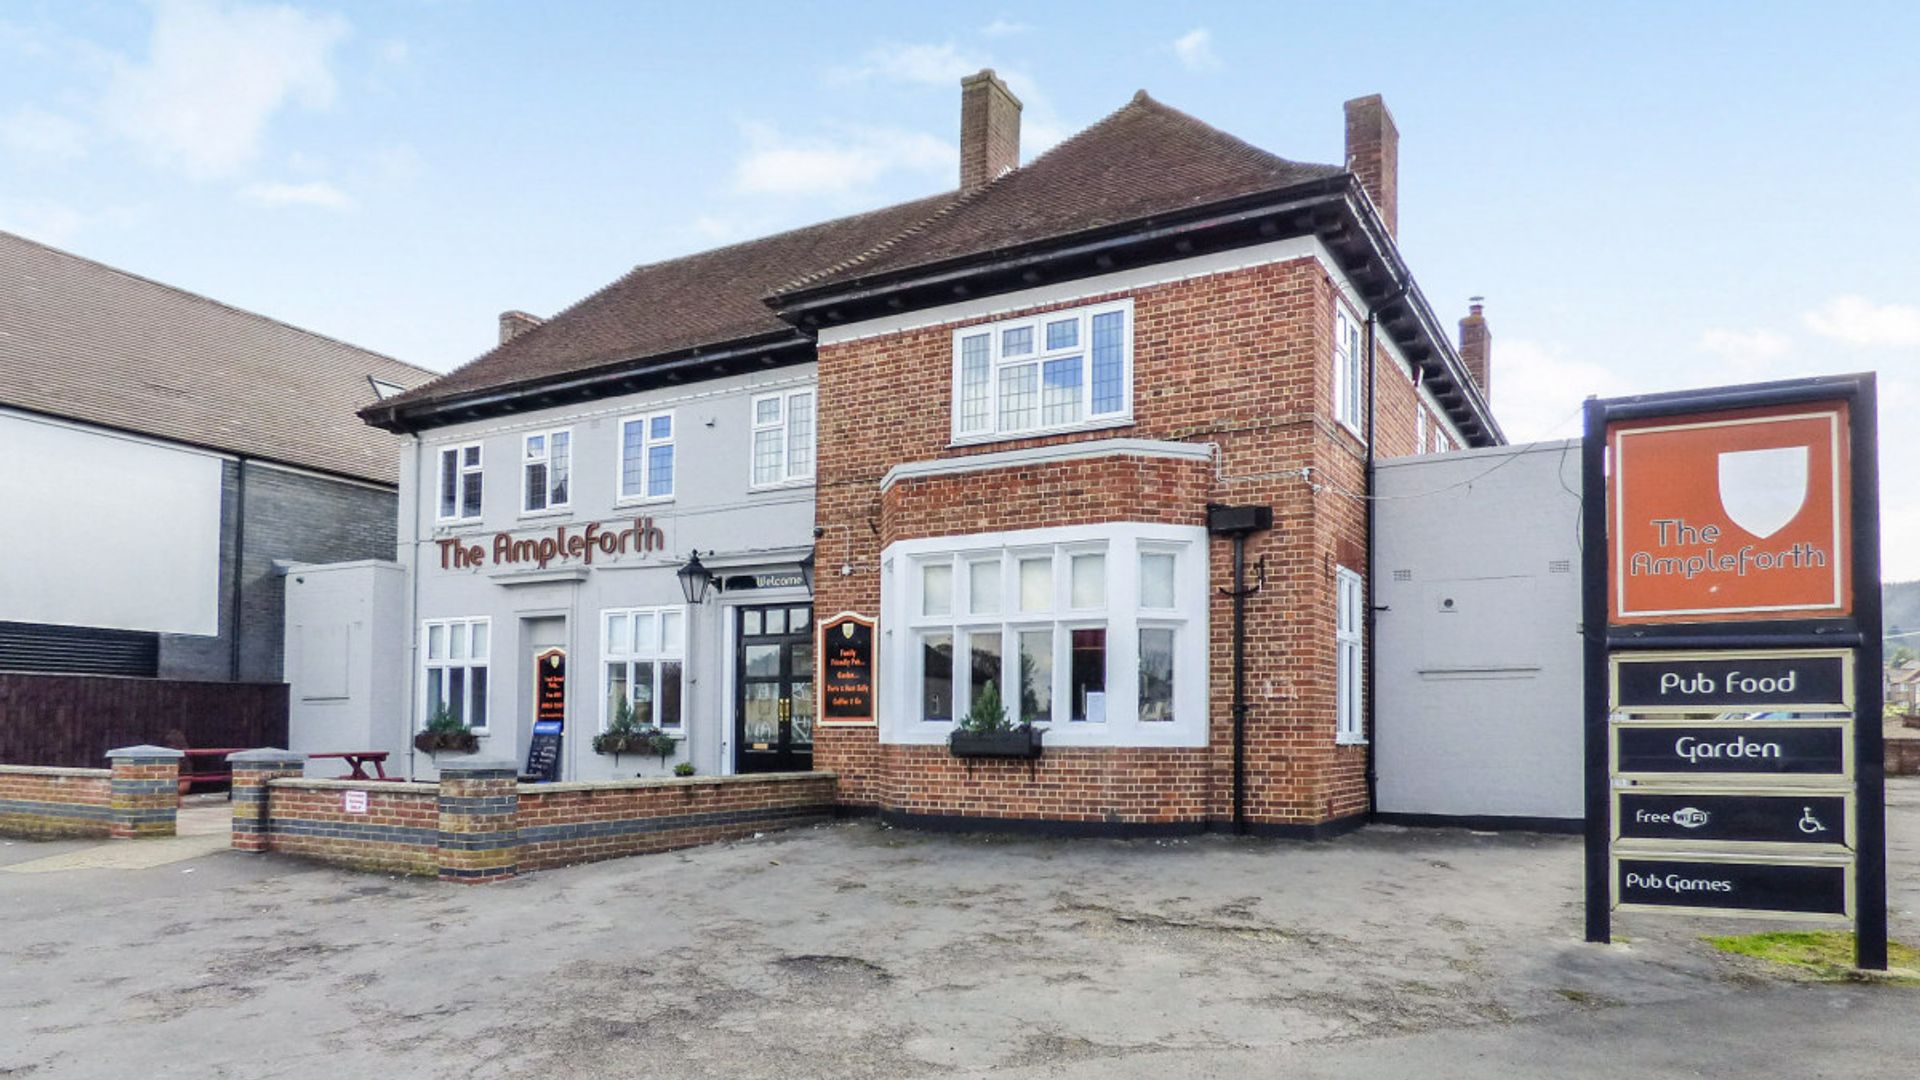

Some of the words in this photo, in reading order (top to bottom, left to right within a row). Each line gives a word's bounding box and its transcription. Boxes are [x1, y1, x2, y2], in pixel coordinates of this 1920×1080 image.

[436, 536, 485, 570] The
[493, 517, 664, 570] Ampleforth
[1650, 519, 1720, 546] The
[1631, 544, 1826, 579] Ampleforth
[756, 575, 803, 588] Welcome
[1660, 672, 1715, 695] Pub
[1726, 670, 1796, 694] Food
[1675, 736, 1781, 763] Garden
[1636, 809, 1670, 823] Free
[1626, 873, 1662, 889] Pub
[1666, 875, 1732, 892] Games
